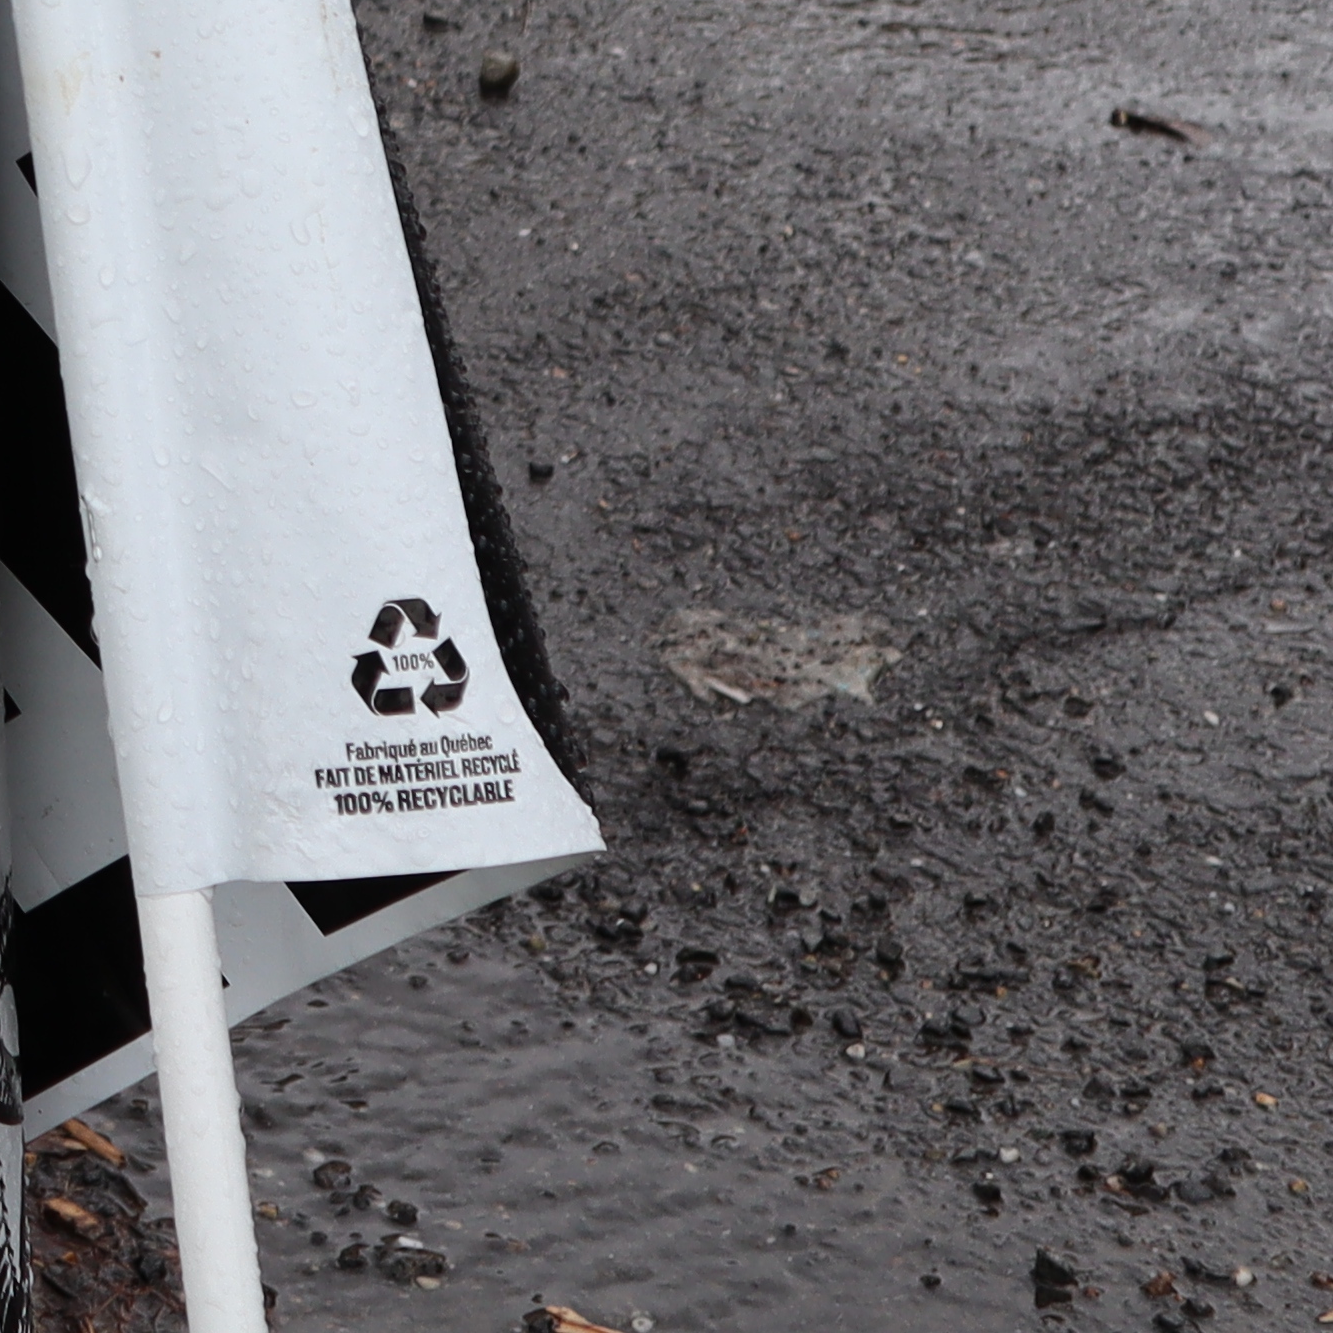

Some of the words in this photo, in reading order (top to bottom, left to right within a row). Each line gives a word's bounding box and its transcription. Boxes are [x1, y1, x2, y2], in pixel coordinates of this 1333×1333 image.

[391, 652, 435, 672] 100%
[345, 738, 417, 762] Fabriqué
[419, 744, 438, 756] au
[440, 734, 493, 759] Québec
[315, 767, 351, 788] FAIT
[354, 765, 376, 784] DE
[379, 758, 459, 783] MATÉRIEL
[461, 749, 521, 776] RECYCLÉ
[334, 789, 394, 816] 100%
[396, 779, 516, 812] RECYCLABLE
